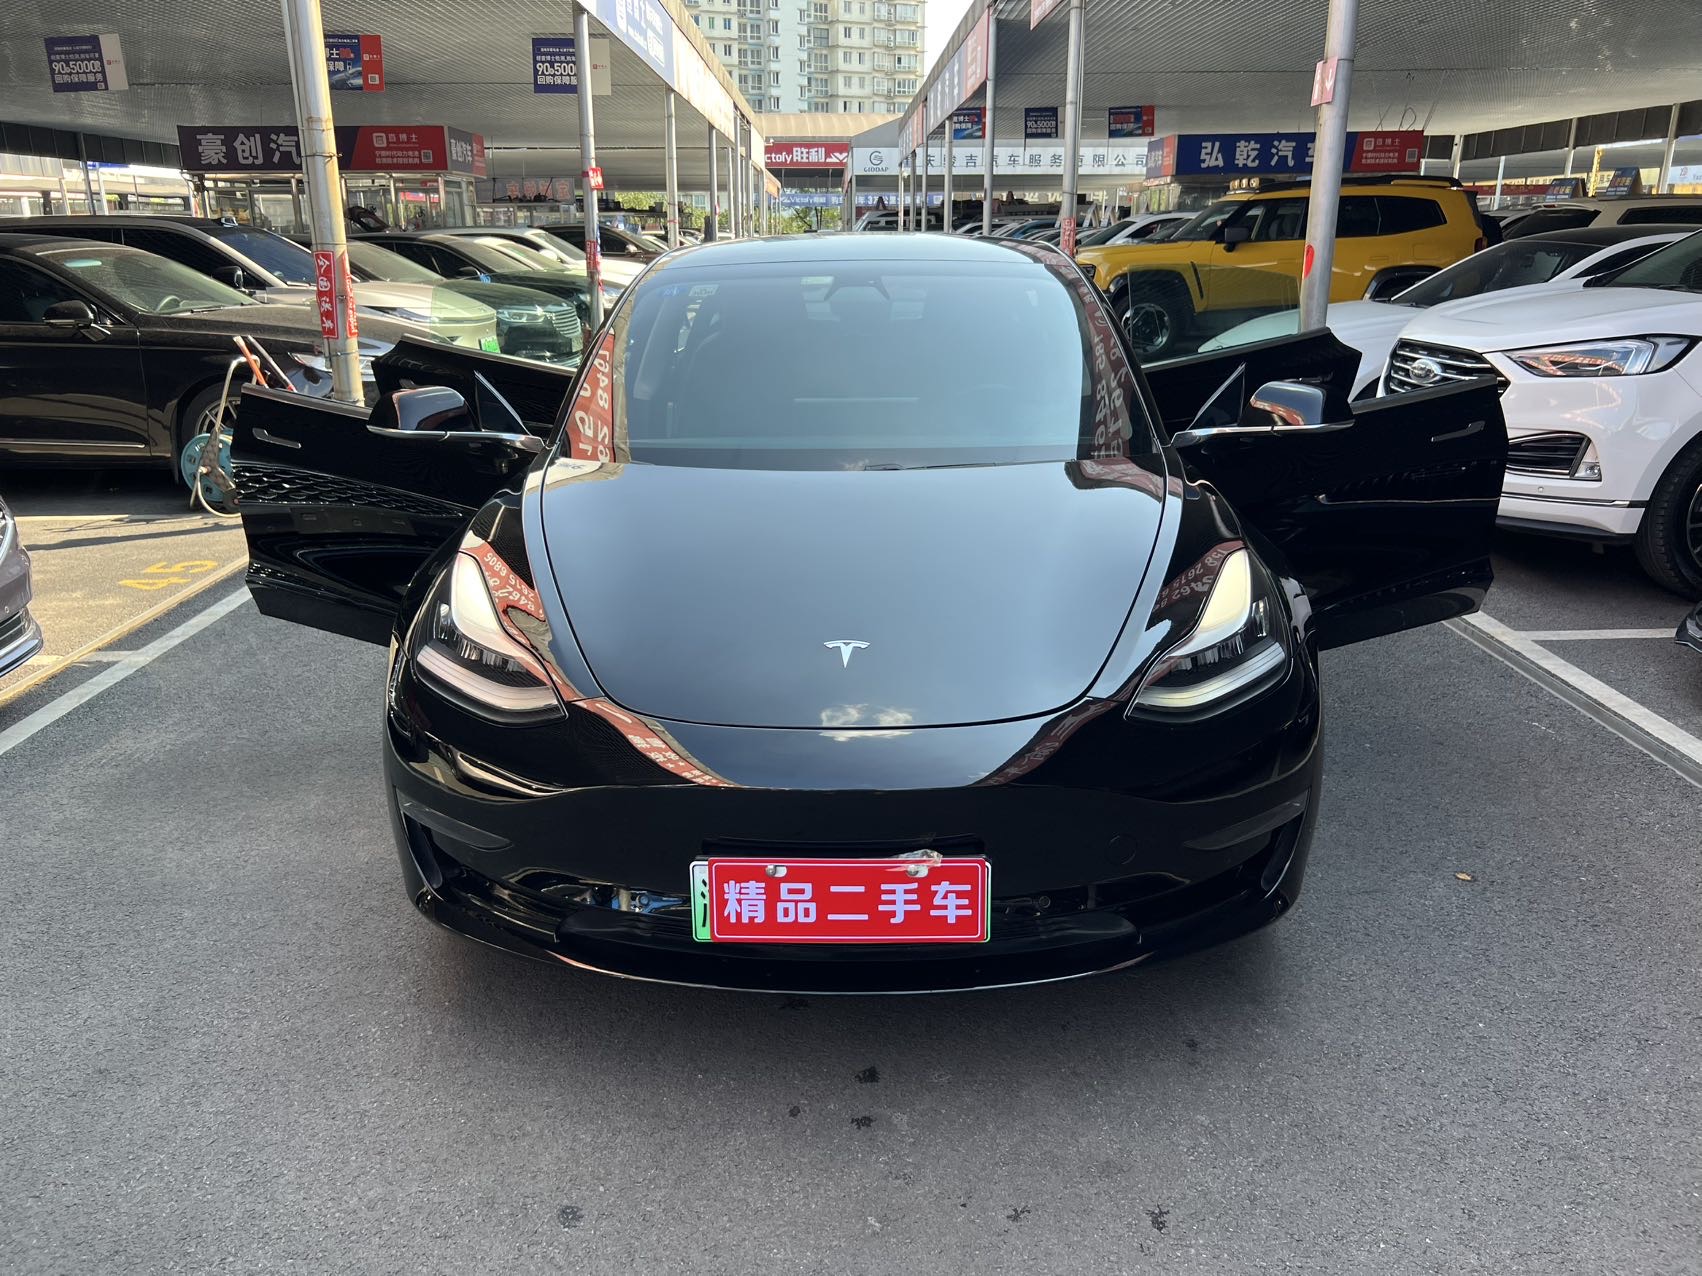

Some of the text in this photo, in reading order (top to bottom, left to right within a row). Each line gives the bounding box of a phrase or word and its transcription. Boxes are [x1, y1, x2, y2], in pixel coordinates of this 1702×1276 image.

[54, 73, 103, 84] 回购保障服务
[792, 147, 826, 162] 胜利
[722, 879, 973, 924] 精品二手车
